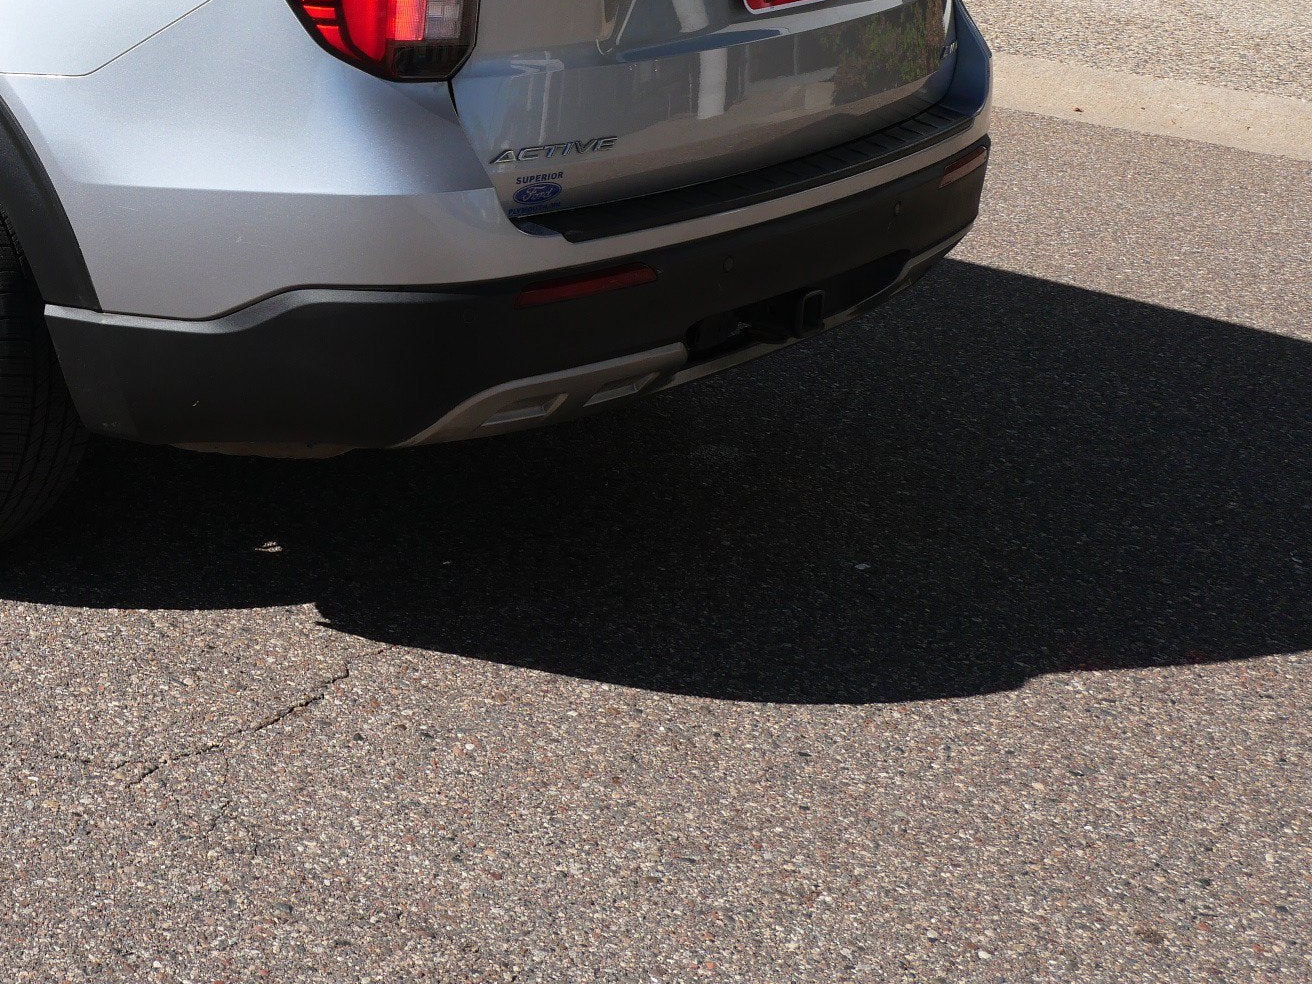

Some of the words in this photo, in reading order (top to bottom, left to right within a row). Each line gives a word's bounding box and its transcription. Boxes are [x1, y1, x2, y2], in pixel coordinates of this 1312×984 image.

[488, 135, 618, 165] ACTIVE
[515, 171, 564, 185] SUPERIOR
[522, 185, 554, 202] Ford
